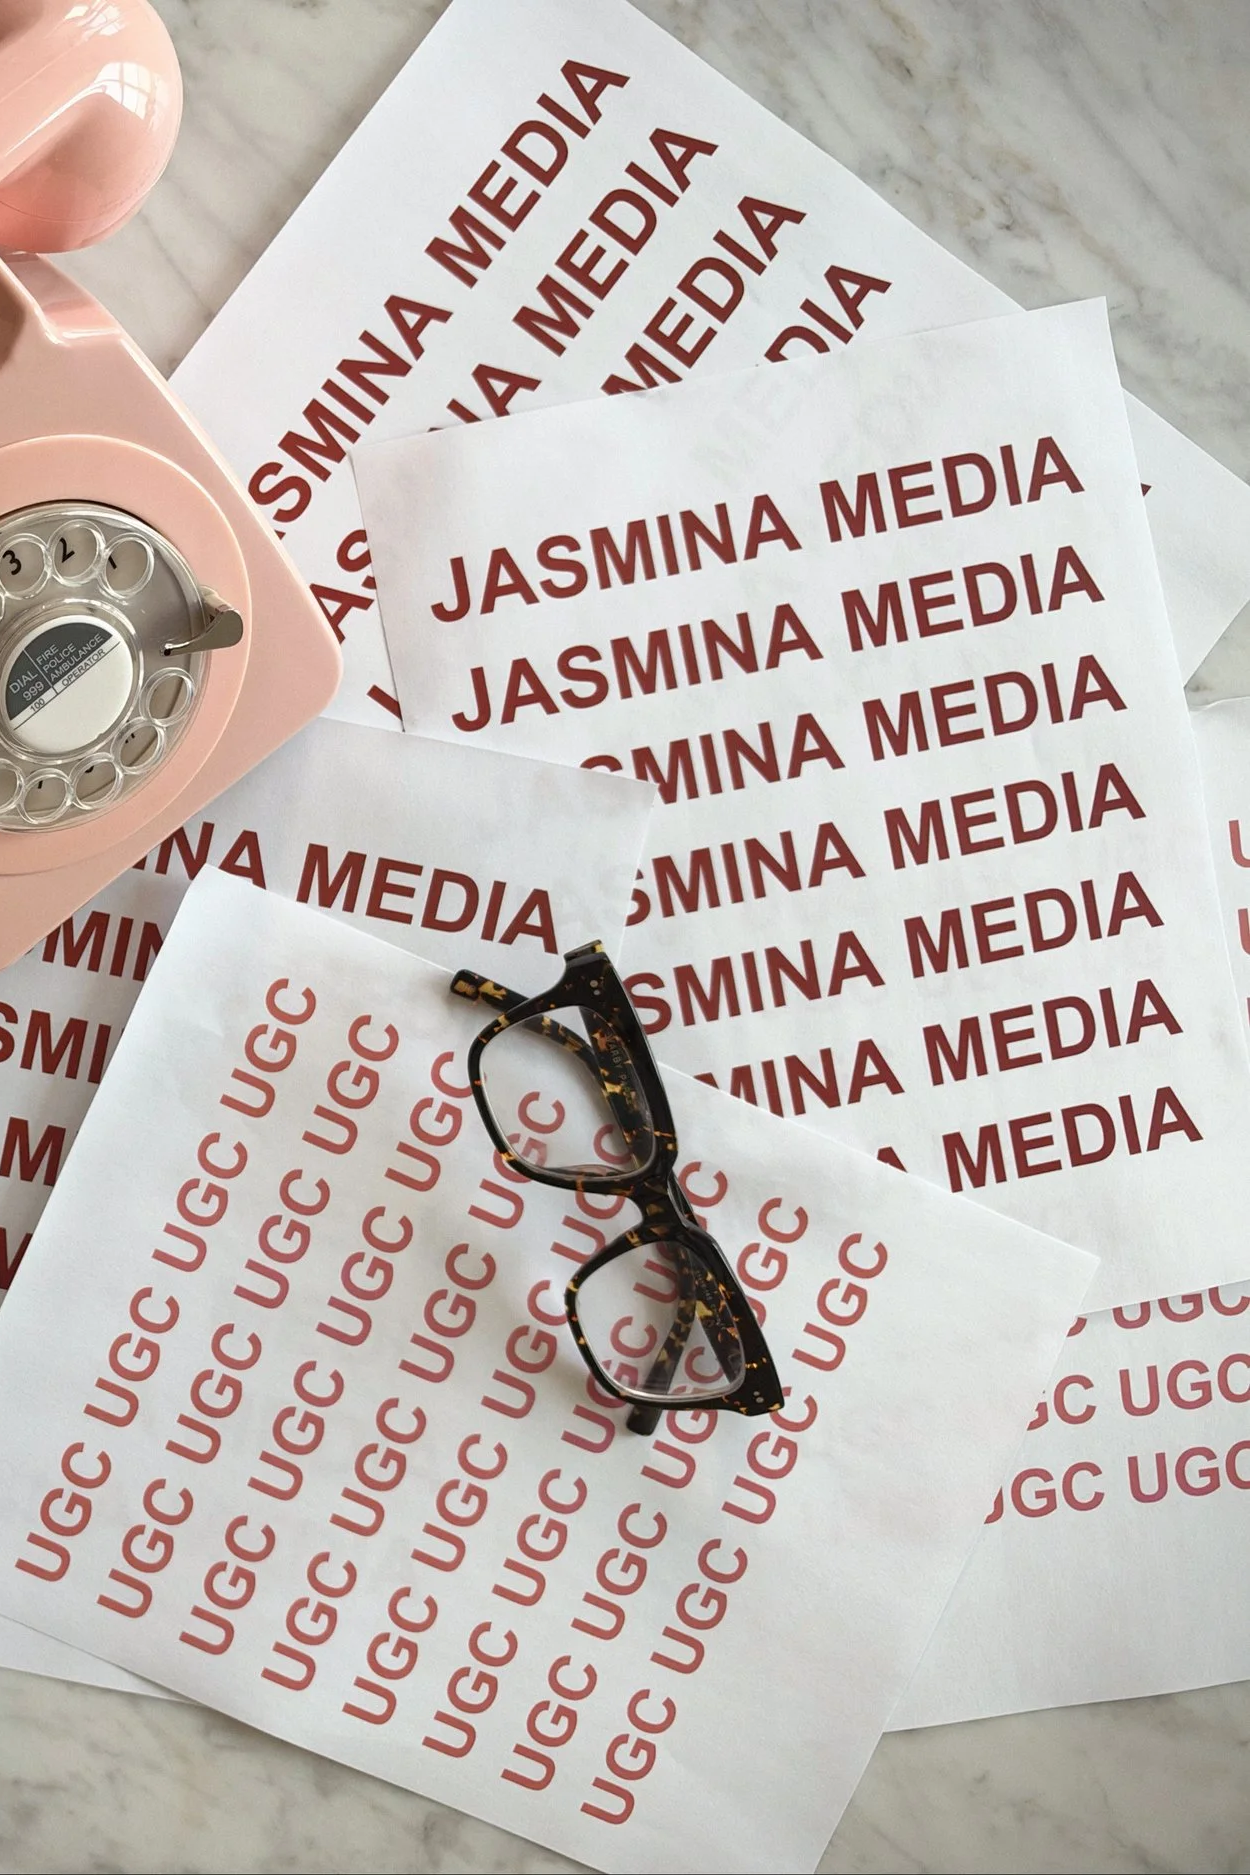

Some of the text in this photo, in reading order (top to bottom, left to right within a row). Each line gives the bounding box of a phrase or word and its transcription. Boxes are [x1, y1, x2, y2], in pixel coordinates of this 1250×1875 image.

[248, 295, 451, 541] SMINA
[425, 60, 628, 287] MEDIA
[513, 128, 717, 355] MEDIA
[2, 550, 22, 576] 3
[59, 537, 75, 563] 2
[431, 437, 1083, 623] JASMINA MEDIA
[10, 670, 38, 694] DIAL
[23, 681, 44, 701] 999
[30, 648, 105, 712] 100 OPERATOR
[36, 644, 59, 665] FIRE
[43, 643, 77, 673] POLICE
[50, 634, 104, 681] AMBULANCE
[452, 546, 1103, 732] JASMINA MEDIA
[863, 655, 1125, 761] MEDIA
[885, 763, 1145, 869] MEDIA
[132, 822, 558, 954] NA MEDIA
[622, 931, 884, 1035] SMINA
[904, 871, 1163, 978] MEDIA
[923, 979, 1182, 1085] MEDIA
[942, 1087, 1201, 1193] MEDIA
[15, 978, 317, 1582] UGC UGC UGC UGC
[97, 1014, 399, 1619] UGC UGC UGC UGC
[180, 1051, 473, 1655] UGC UGC UGC UGC
[1119, 1353, 1250, 1416] UGC
[261, 1552, 357, 1691] UGC
[330, 1398, 427, 1537] UGC
[399, 1243, 497, 1383] UGC
[342, 1587, 438, 1725] UGC
[412, 1434, 508, 1572] UGC
[482, 1280, 569, 1419] UGC
[1128, 1440, 1250, 1503] UGC
[581, 1233, 888, 1825] UGC UGC UGC UGC
[423, 1621, 518, 1758] UGC
[493, 1469, 587, 1606] UGC
[501, 1655, 597, 1791] UGC
[572, 1503, 667, 1641] UGC
